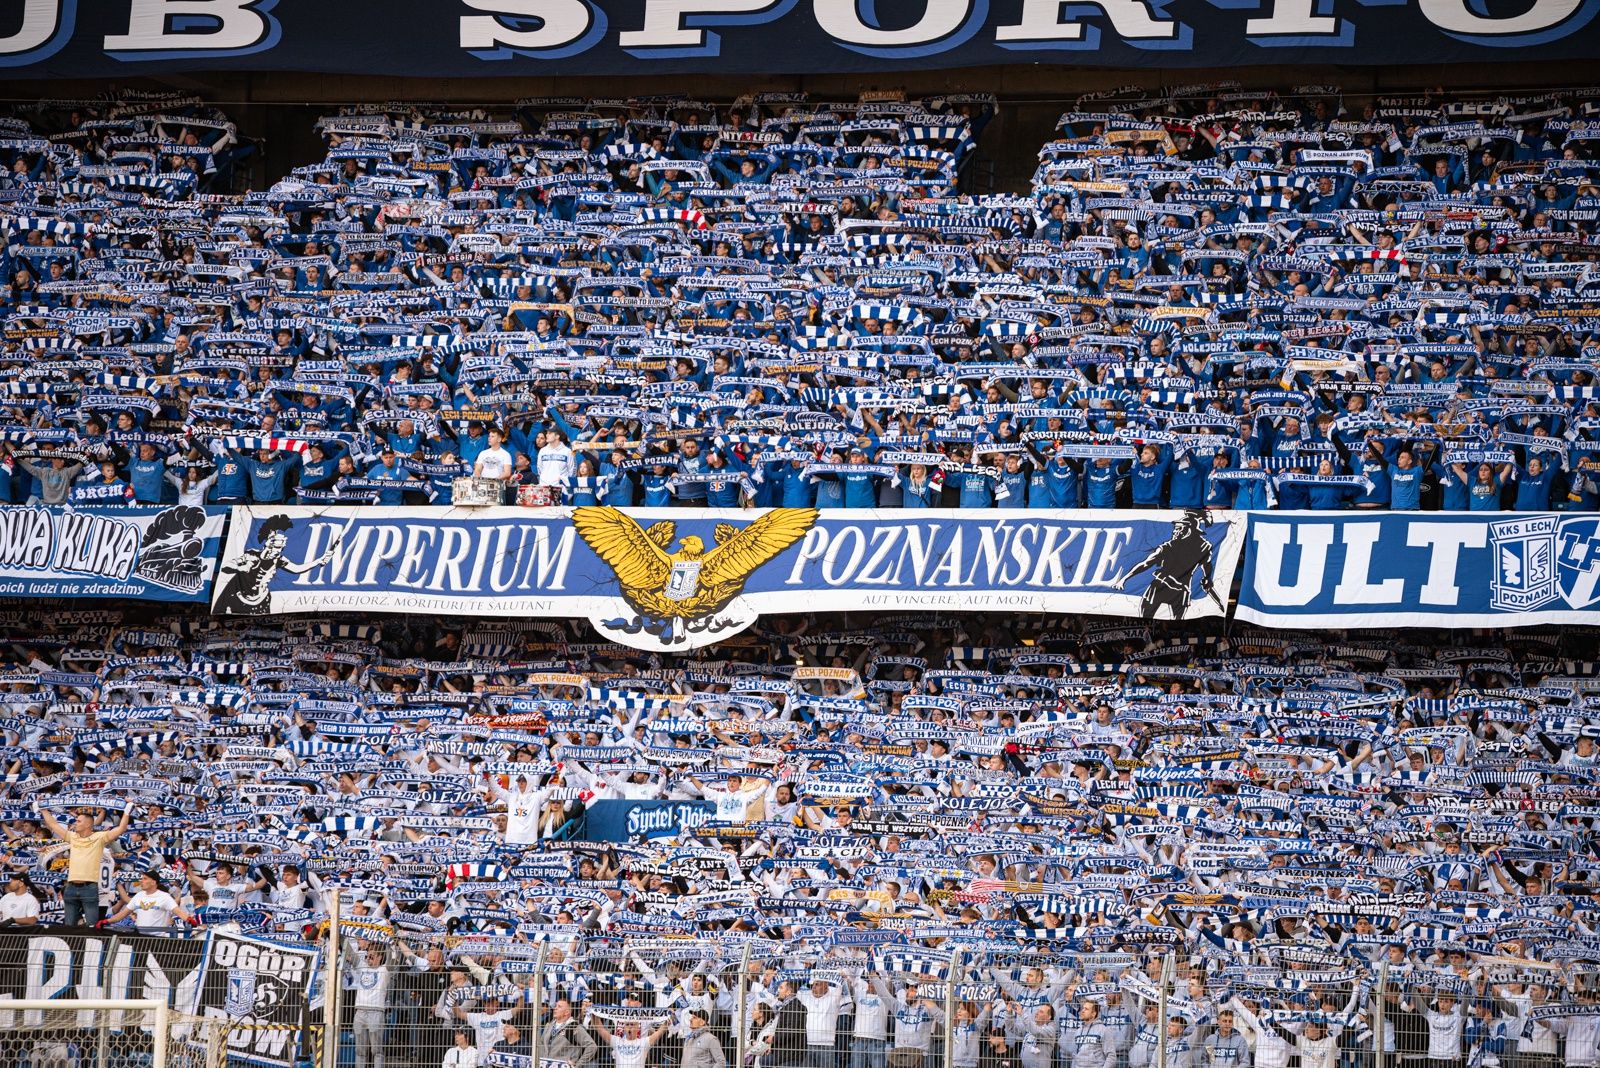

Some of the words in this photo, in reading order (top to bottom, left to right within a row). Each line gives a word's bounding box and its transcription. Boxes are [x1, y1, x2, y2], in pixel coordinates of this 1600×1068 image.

[1380, 109, 1439, 117] KOLEJORZ
[1450, 103, 1507, 114] LECH
[850, 120, 892, 129] LECH
[1176, 193, 1235, 202] KOLEJORZ
[1527, 264, 1584, 273] KOLEJORZ
[857, 336, 879, 344] KOLE
[441, 411, 460, 420] LECH
[592, 408, 639, 416] OLEJORZ
[785, 422, 842, 430] KOLEJORZ
[114, 432, 140, 441] Lech
[622, 459, 642, 468] LECH
[1499, 525, 1520, 537] KKS
[1525, 521, 1552, 533] LECH
[0, 508, 53, 569] WA
[54, 512, 140, 581] KLIKA
[292, 522, 578, 593] IMPERIUM
[784, 519, 1134, 590] POZNAŃSKIE
[1253, 521, 1489, 606] ULT
[29, 582, 57, 594] ludzi
[61, 583, 80, 594] nie
[82, 584, 146, 596] zdradzimy
[1502, 586, 1549, 604] POZNAŃ
[294, 596, 318, 606] AVE
[394, 598, 464, 610] MORITURI
[468, 601, 485, 611] TE
[488, 601, 554, 611] SALUTANT
[862, 595, 890, 605] AUT
[964, 595, 992, 605] AUT
[996, 595, 1033, 605] MORI
[797, 669, 816, 677] LECH
[690, 674, 708, 682] LECH
[514, 702, 537, 710] KOLE
[110, 707, 165, 721] Kolejorz
[384, 710, 408, 718] LECH
[215, 726, 271, 736] MAJSTER
[1283, 728, 1320, 737] NOWY
[228, 748, 275, 757] KOLEJORZ
[808, 784, 843, 792] FORZA
[846, 785, 870, 794] LECH
[1490, 801, 1520, 810] ANTY
[627, 804, 674, 834] Fyrtel
[1126, 826, 1179, 835] OLEJORZ
[1392, 834, 1430, 843] ANTY
[511, 868, 524, 876] KKS
[526, 868, 540, 876] LECH
[1277, 868, 1354, 877] TRZCIANKA
[838, 933, 865, 941] MISTRZ
[868, 933, 896, 941] POLSKI
[1123, 934, 1176, 942] MAJSTER
[213, 939, 306, 983] OGÓR
[506, 963, 529, 971] LECH
[1286, 972, 1356, 982] GRUNWALD
[1489, 974, 1556, 983] KOLEJOR
[917, 984, 947, 999] MISTR
